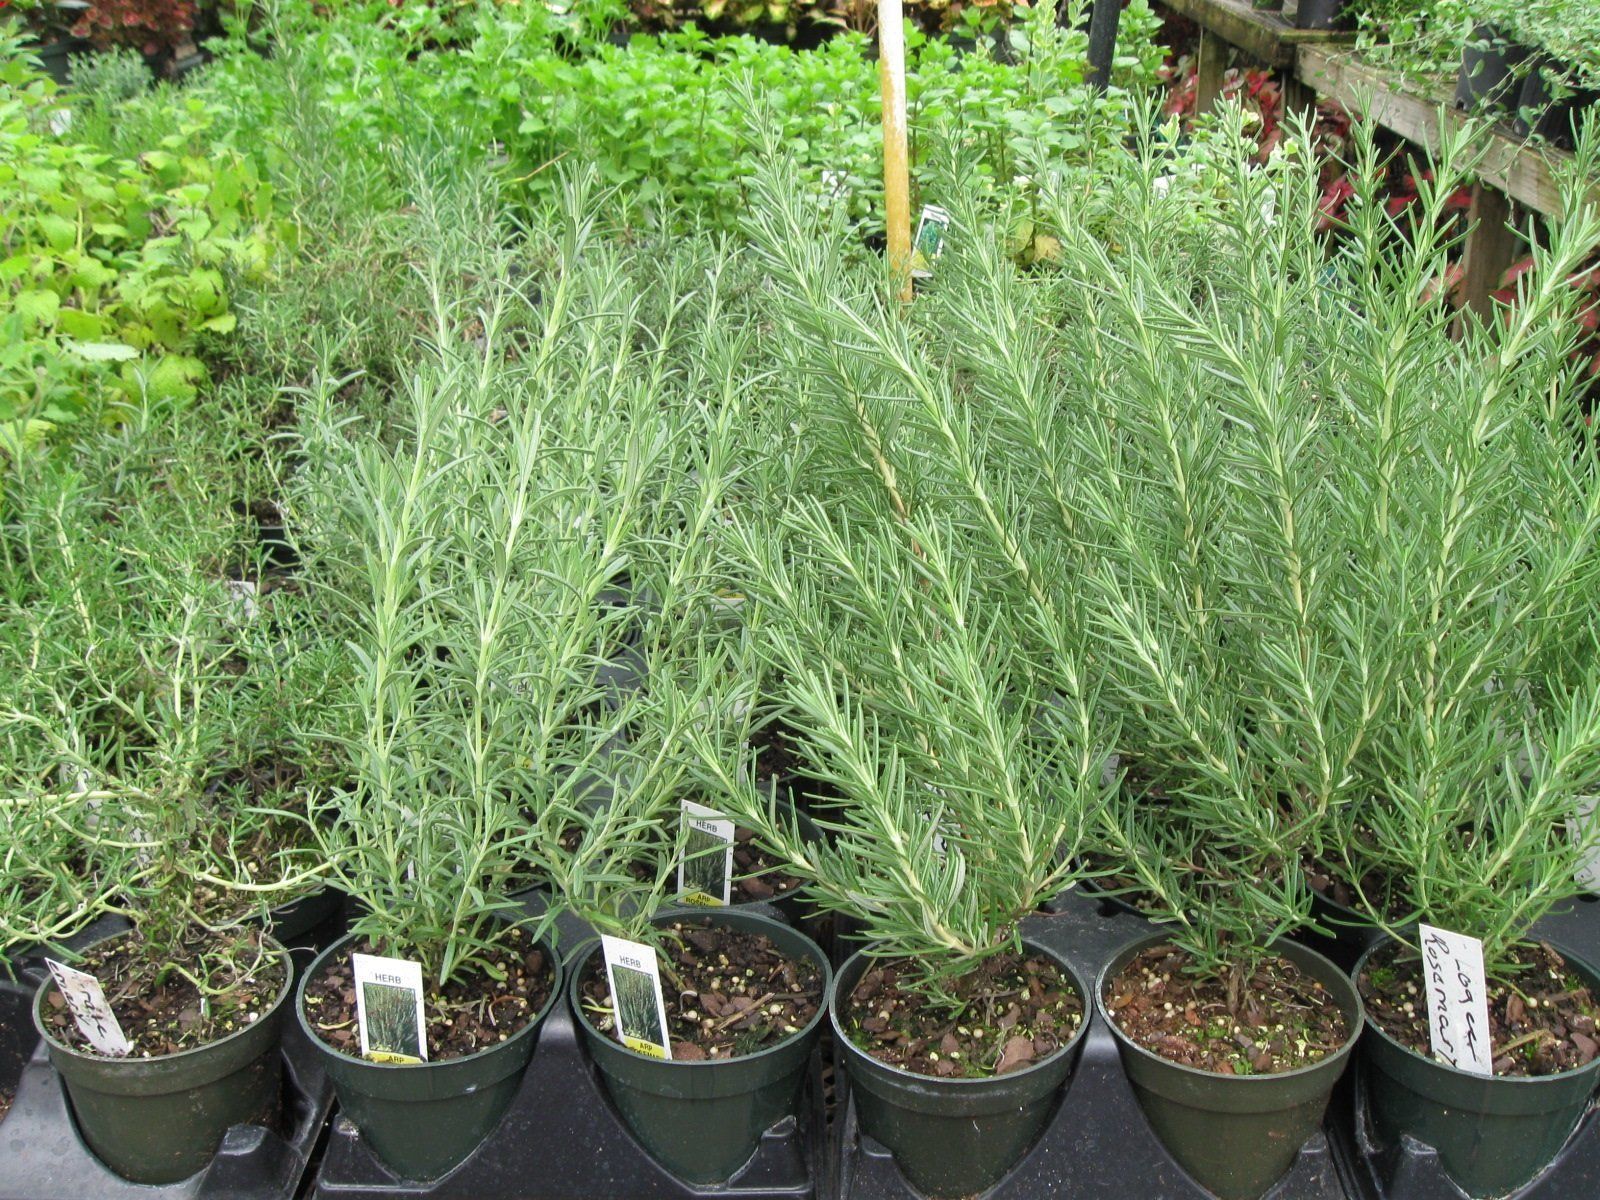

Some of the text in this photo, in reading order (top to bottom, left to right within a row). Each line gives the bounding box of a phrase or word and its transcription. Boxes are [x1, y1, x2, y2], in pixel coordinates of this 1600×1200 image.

[696, 820, 718, 833] HERB
[619, 955, 642, 969] HERB
[374, 972, 402, 984] HERB
[1424, 932, 1458, 1068] Rosemary
[639, 1042, 653, 1051] ARP
